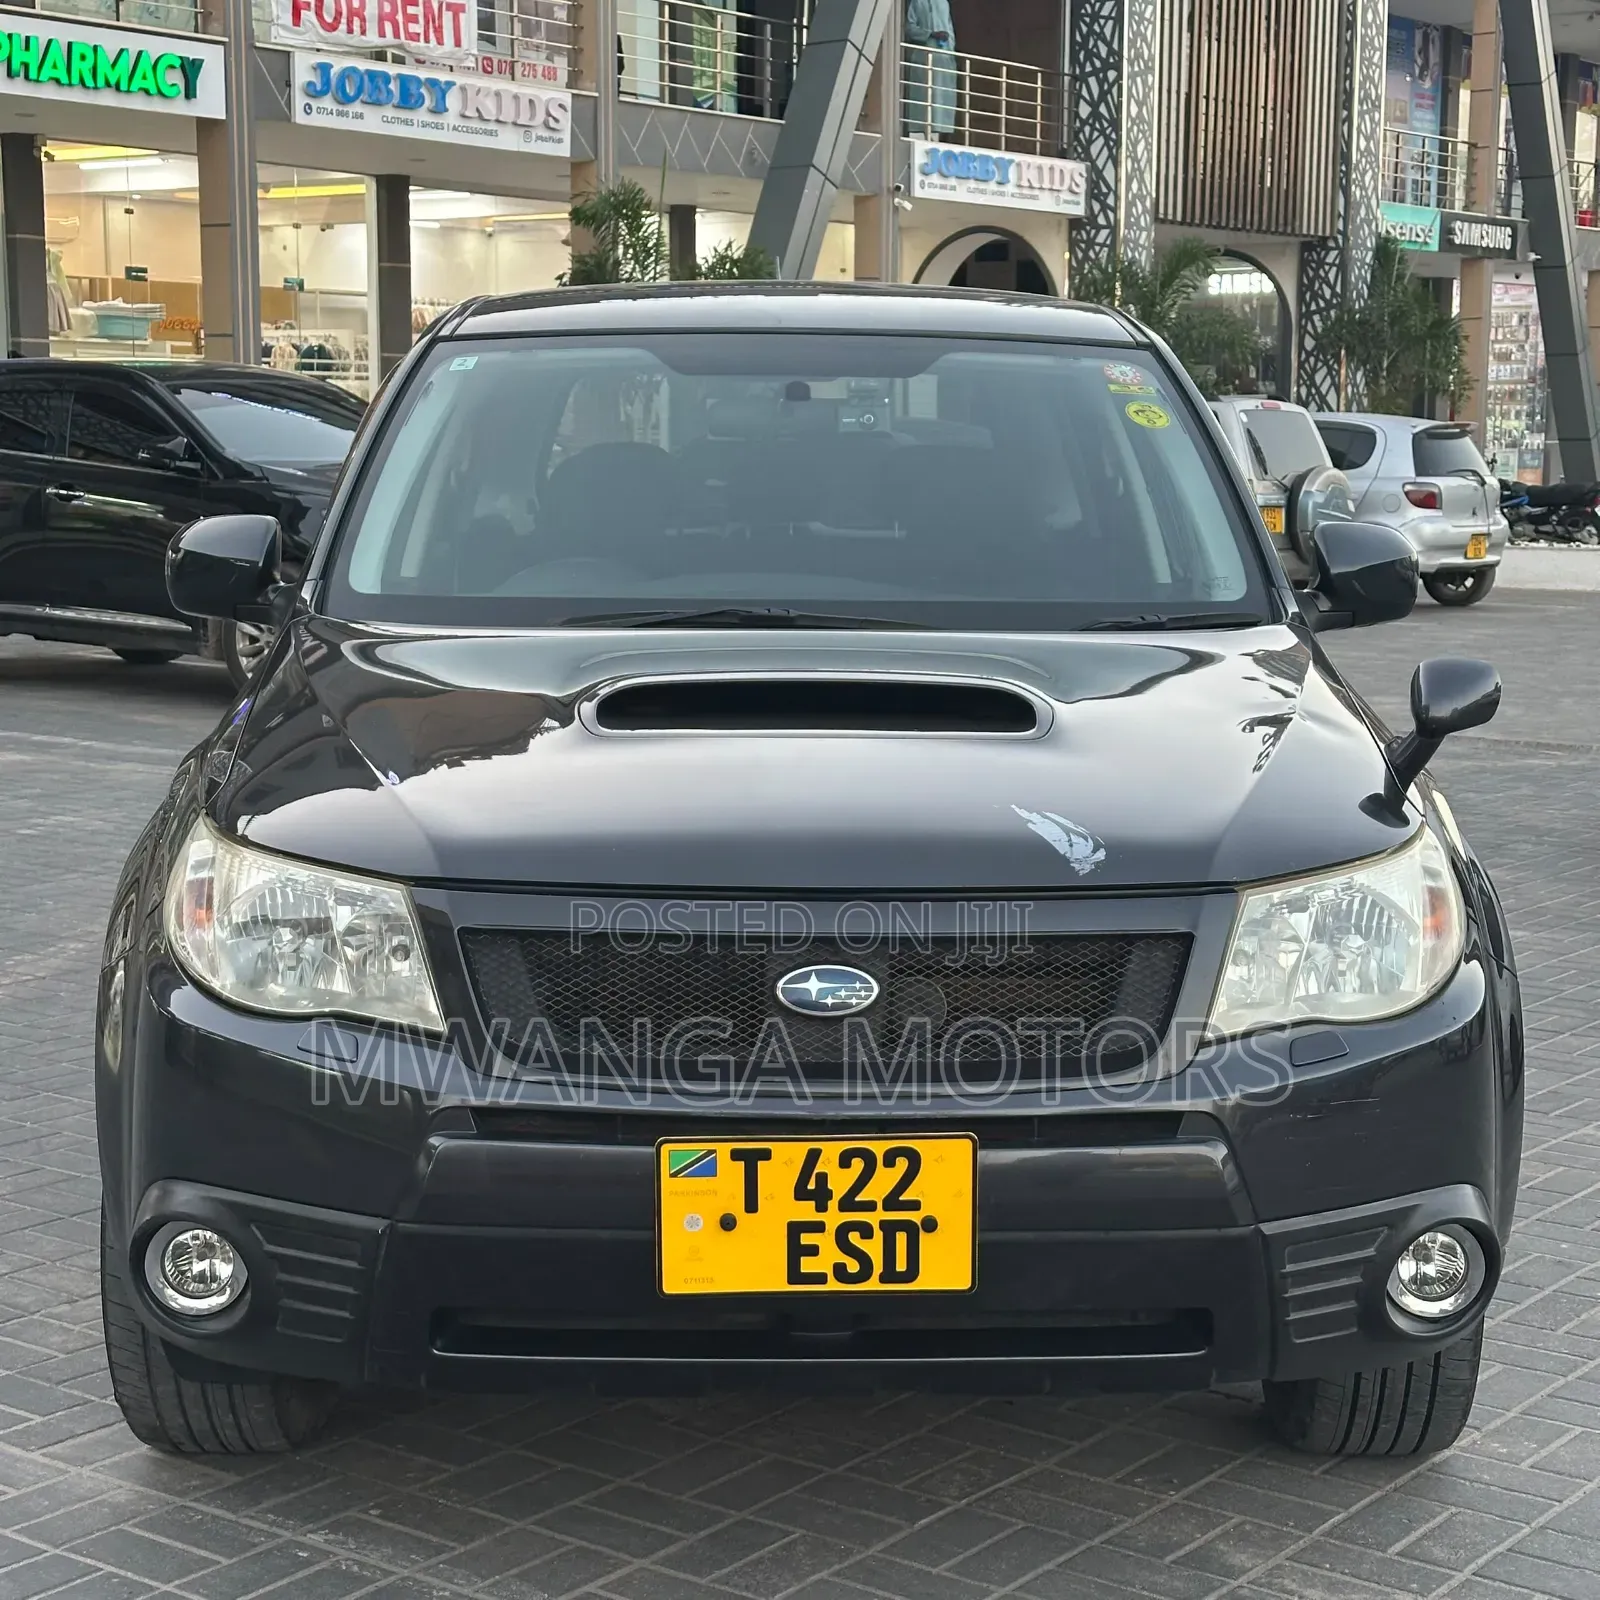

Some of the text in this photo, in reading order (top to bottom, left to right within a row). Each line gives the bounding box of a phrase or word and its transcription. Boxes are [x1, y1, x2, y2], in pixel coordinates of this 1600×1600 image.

[291, 0, 467, 48] FOR RENT
[303, 61, 569, 131] JOBBY KIDS
[381, 114, 499, 138] CLOTHES SHOES ACCESSORIES
[920, 147, 1088, 195] JOBBY KIDS
[1453, 220, 1513, 250] SAMSUNG
[730, 1145, 923, 1214] T 422
[786, 1218, 921, 1286] ESD
